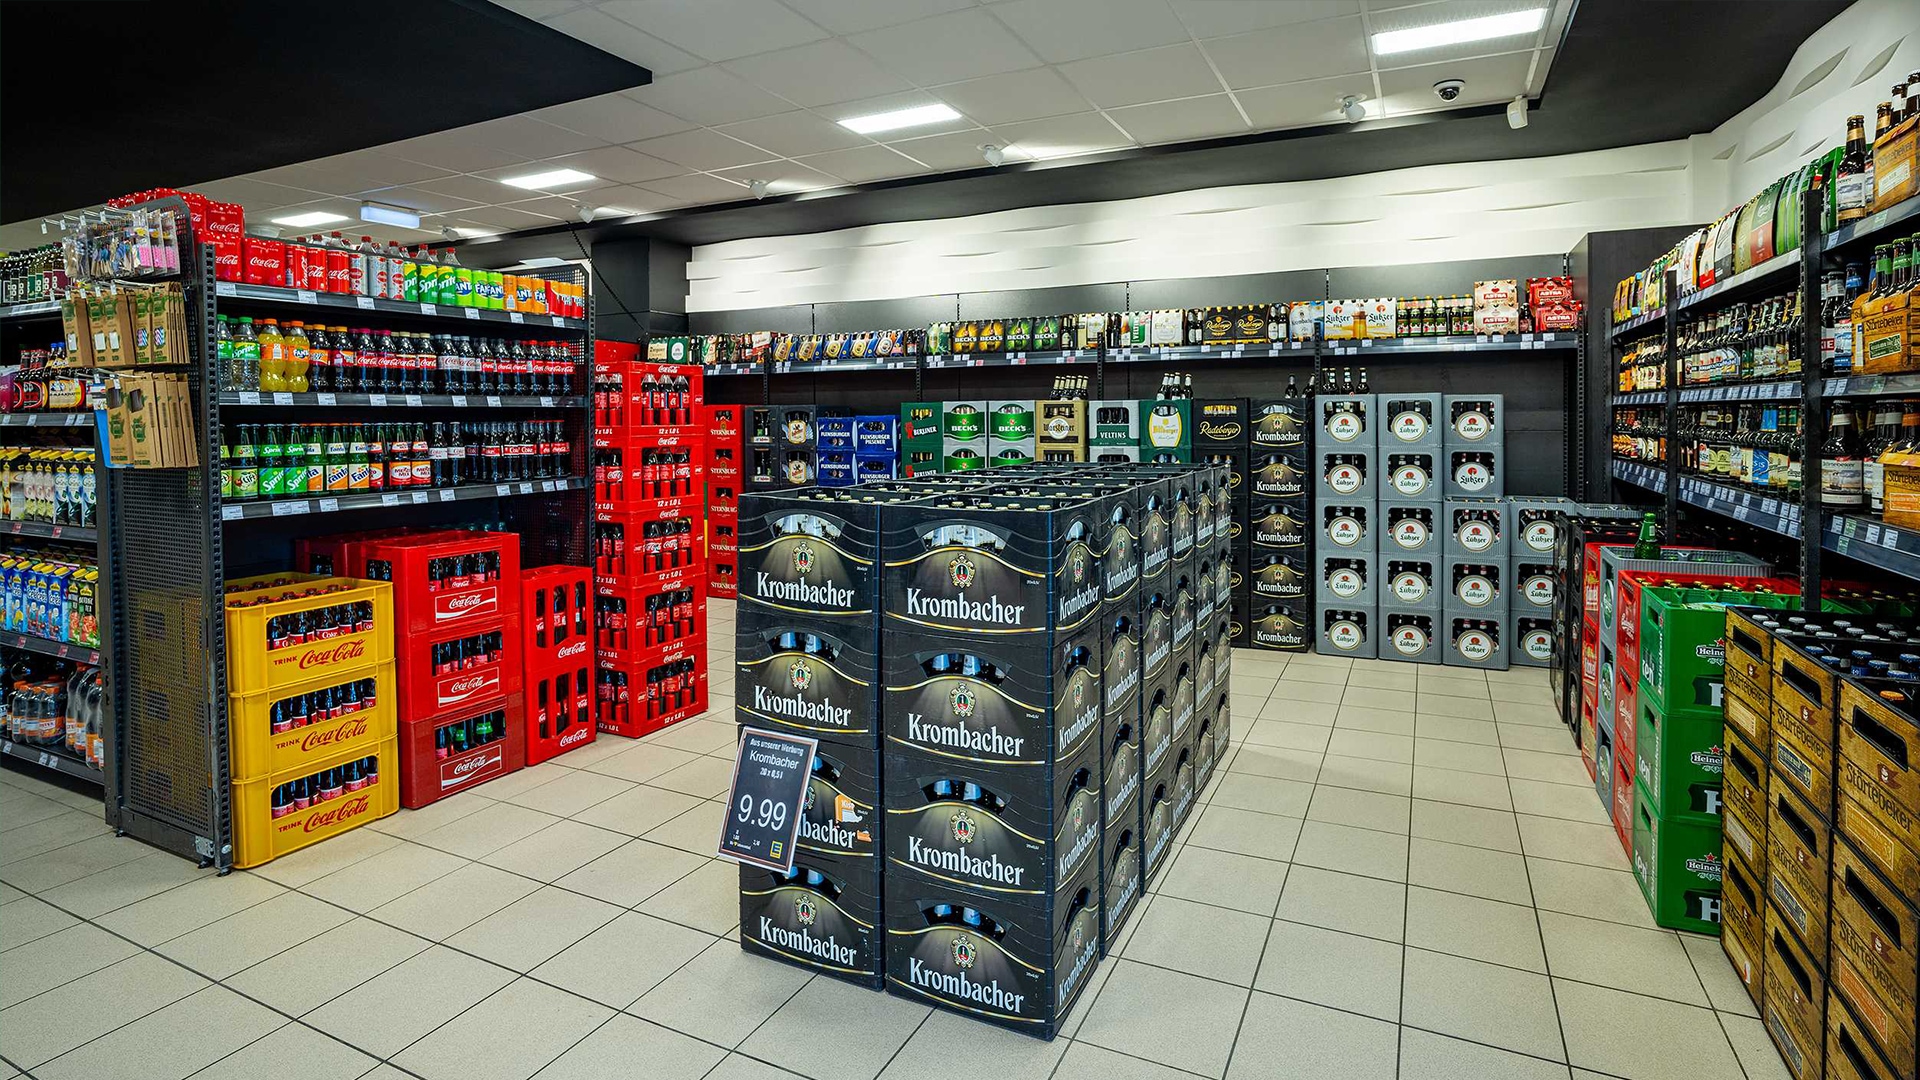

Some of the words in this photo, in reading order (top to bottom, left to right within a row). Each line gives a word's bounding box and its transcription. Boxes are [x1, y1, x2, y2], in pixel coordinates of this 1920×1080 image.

[420, 276, 438, 293] Spri
[1866, 315, 1904, 331] Störtebeker
[1100, 431, 1126, 439] VELTINS
[1200, 421, 1238, 435] Radeberger
[1256, 431, 1301, 442] Krombacher
[263, 470, 284, 491] Sprit
[287, 469, 307, 490] Sprit
[351, 467, 370, 482] Fant
[1888, 470, 1920, 484] Störtebe
[1256, 481, 1301, 492] Krombacher
[1257, 531, 1302, 543] Krombacher
[1106, 562, 1137, 595] Krombacher
[1257, 581, 1302, 594] Krombacher
[757, 571, 854, 608] Krombacher
[449, 594, 481, 609] Coca-Cola
[907, 588, 1024, 625] Krombacher
[1059, 582, 1099, 621] Krombacher
[1257, 631, 1302, 644] Krombacher
[273, 655, 298, 666] TRINK
[299, 639, 366, 670] Coca-Cola
[558, 641, 586, 659] Coca-Cola
[1699, 648, 1724, 656] Heine
[451, 676, 484, 693] Coca-Cola
[1107, 668, 1138, 707] Krombacher
[755, 685, 851, 726] Krombacher
[276, 738, 300, 750] TRINK
[301, 716, 369, 752] Coca-Cola
[560, 728, 588, 747] Coca-Cola
[908, 713, 1024, 757] Krombacher
[1059, 704, 1098, 752] Krombacher
[1777, 707, 1825, 759] Störtebeker
[761, 741, 781, 750] unserer
[781, 744, 804, 756] Werbung
[454, 755, 486, 774] Coca-Cola
[750, 750, 800, 769] Krombacher
[1694, 755, 1723, 765] Heine
[760, 767, 767, 776] 20
[771, 769, 779, 779] 0,5
[1107, 772, 1138, 820] Krombacher
[1846, 763, 1912, 835] Störtebeker
[278, 820, 303, 833] TRINK
[303, 794, 370, 834] Coca-Cola
[738, 794, 787, 831] 9.99
[800, 813, 856, 849] bacher
[1059, 820, 1098, 880] Krombacher
[908, 836, 1024, 886] Krombacher
[1689, 862, 1721, 872] Heinek
[1107, 875, 1138, 931] Krombacher
[760, 916, 856, 966] Krombacher
[1058, 935, 1097, 1007] Krombacher
[1839, 920, 1906, 1011] Störtebeker
[910, 957, 1024, 1013] Krombacher
